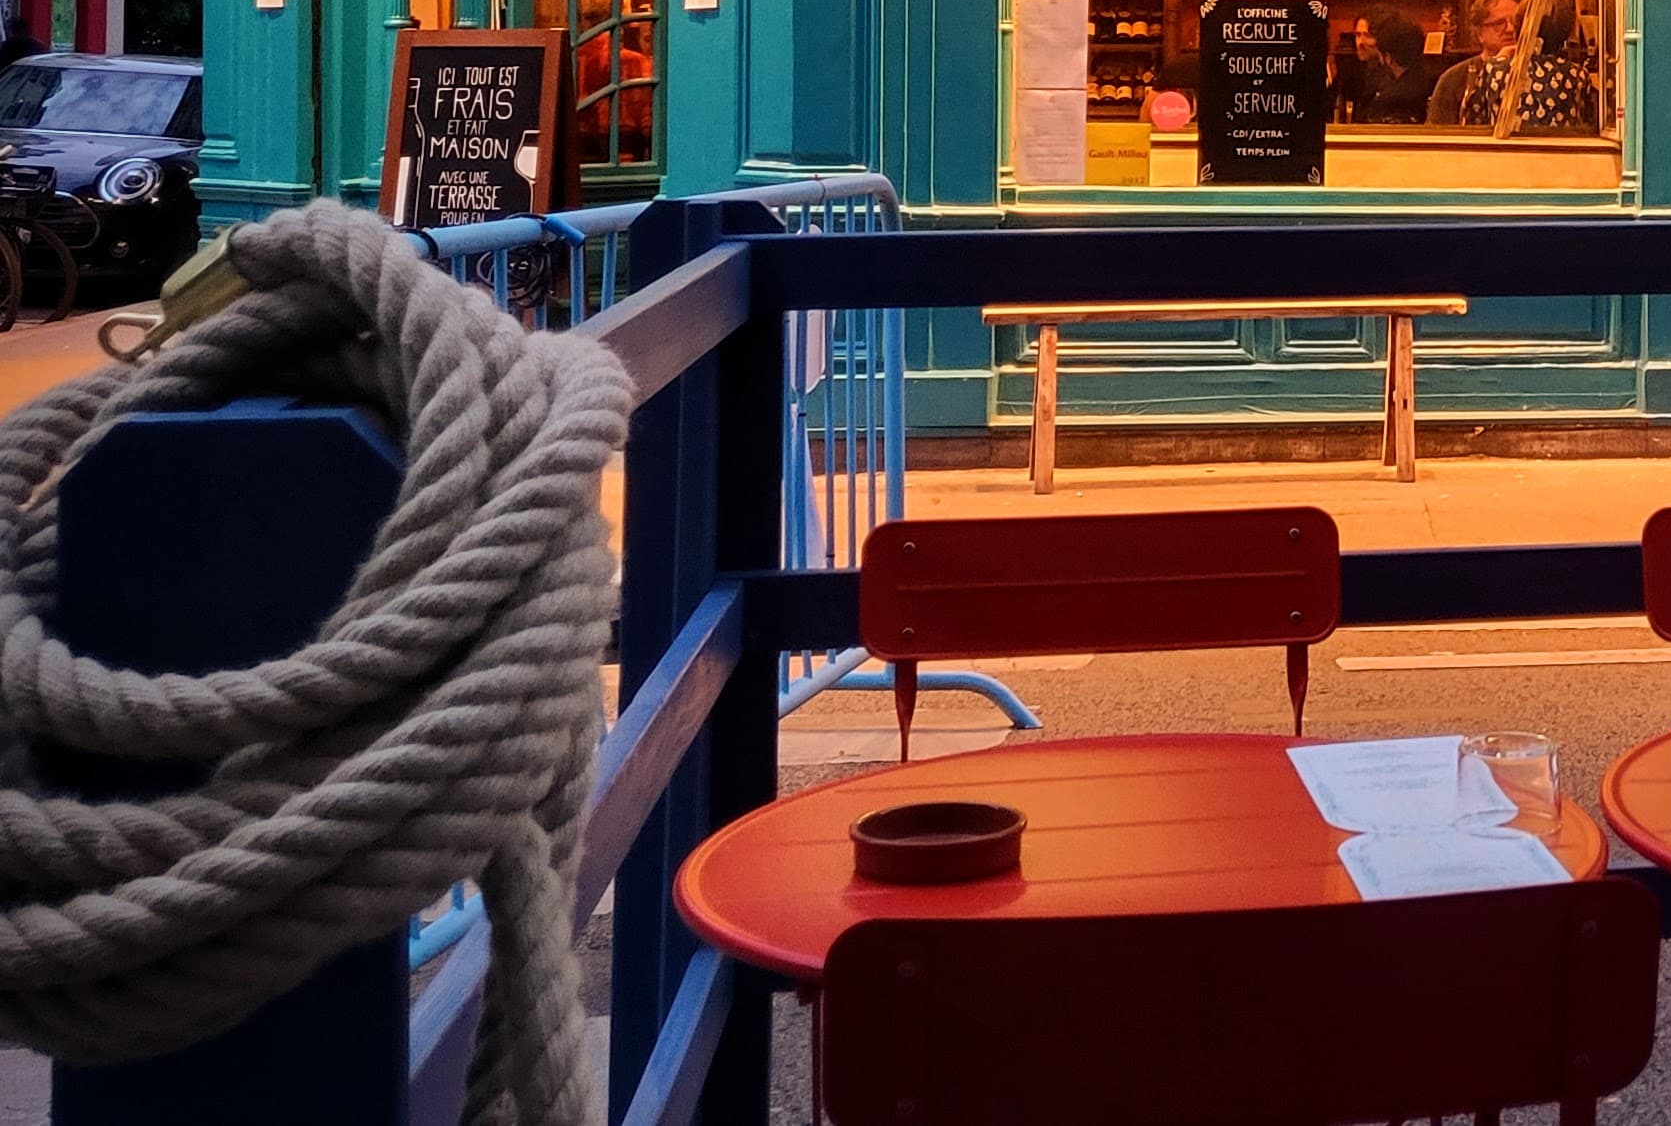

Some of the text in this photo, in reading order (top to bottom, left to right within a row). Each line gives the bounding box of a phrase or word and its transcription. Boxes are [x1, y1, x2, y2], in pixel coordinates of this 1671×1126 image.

[1237, 8, 1289, 20] L'OFFICINE
[1222, 22, 1298, 41] RECRUTE
[1228, 56, 1297, 75] SOUS CHEF
[437, 66, 520, 87] ICI TOUT EST
[434, 87, 516, 120] FRAIS
[1234, 92, 1296, 114] SERVEUR
[447, 119, 489, 136] ET FAIT
[429, 136, 510, 160] MAISON
[1236, 147, 1290, 157] TEMPS PLEIN
[438, 171, 490, 185] AVEC UNE
[428, 185, 503, 211] TERRASSE
[440, 210, 486, 225] POUR EN
